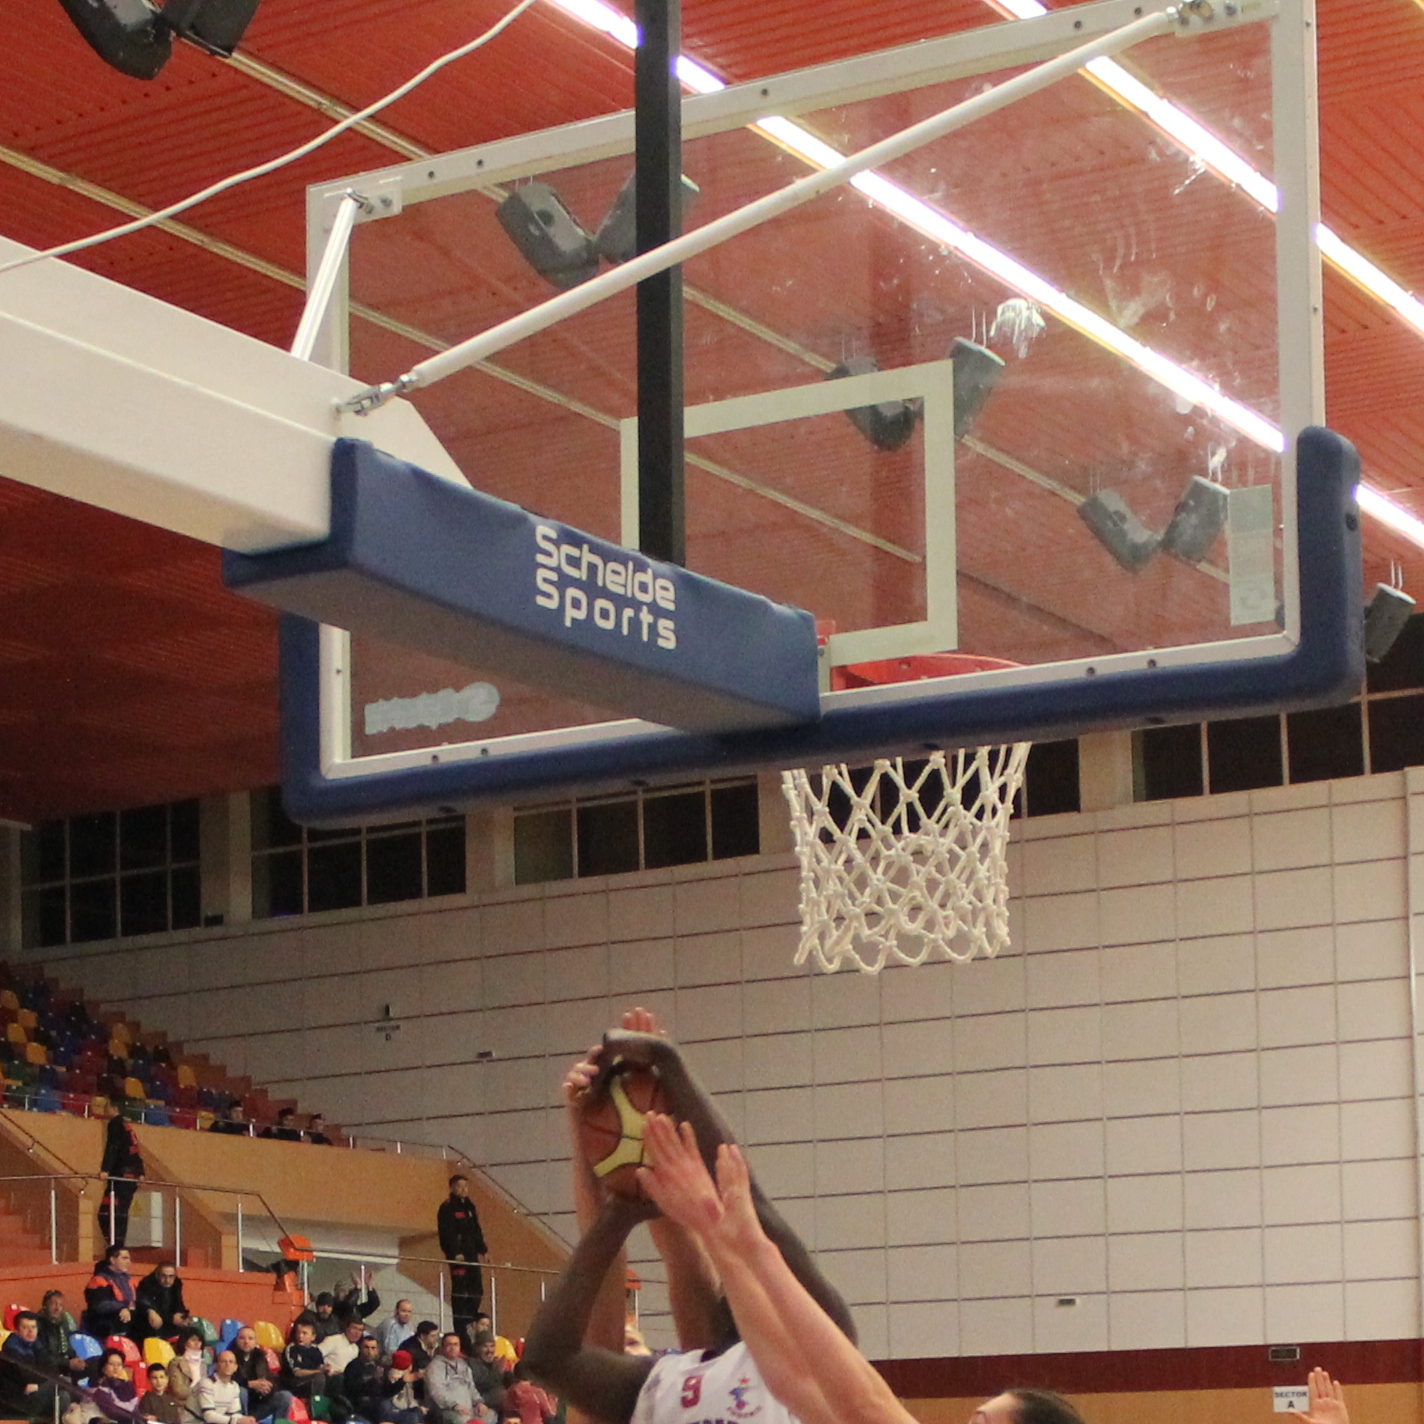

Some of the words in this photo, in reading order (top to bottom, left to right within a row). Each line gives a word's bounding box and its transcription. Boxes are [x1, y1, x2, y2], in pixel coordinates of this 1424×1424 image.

[535, 524, 676, 612] Schelde
[535, 567, 677, 650] Sports
[680, 1374, 703, 1409] 9
[1287, 1400, 1295, 1409] A
